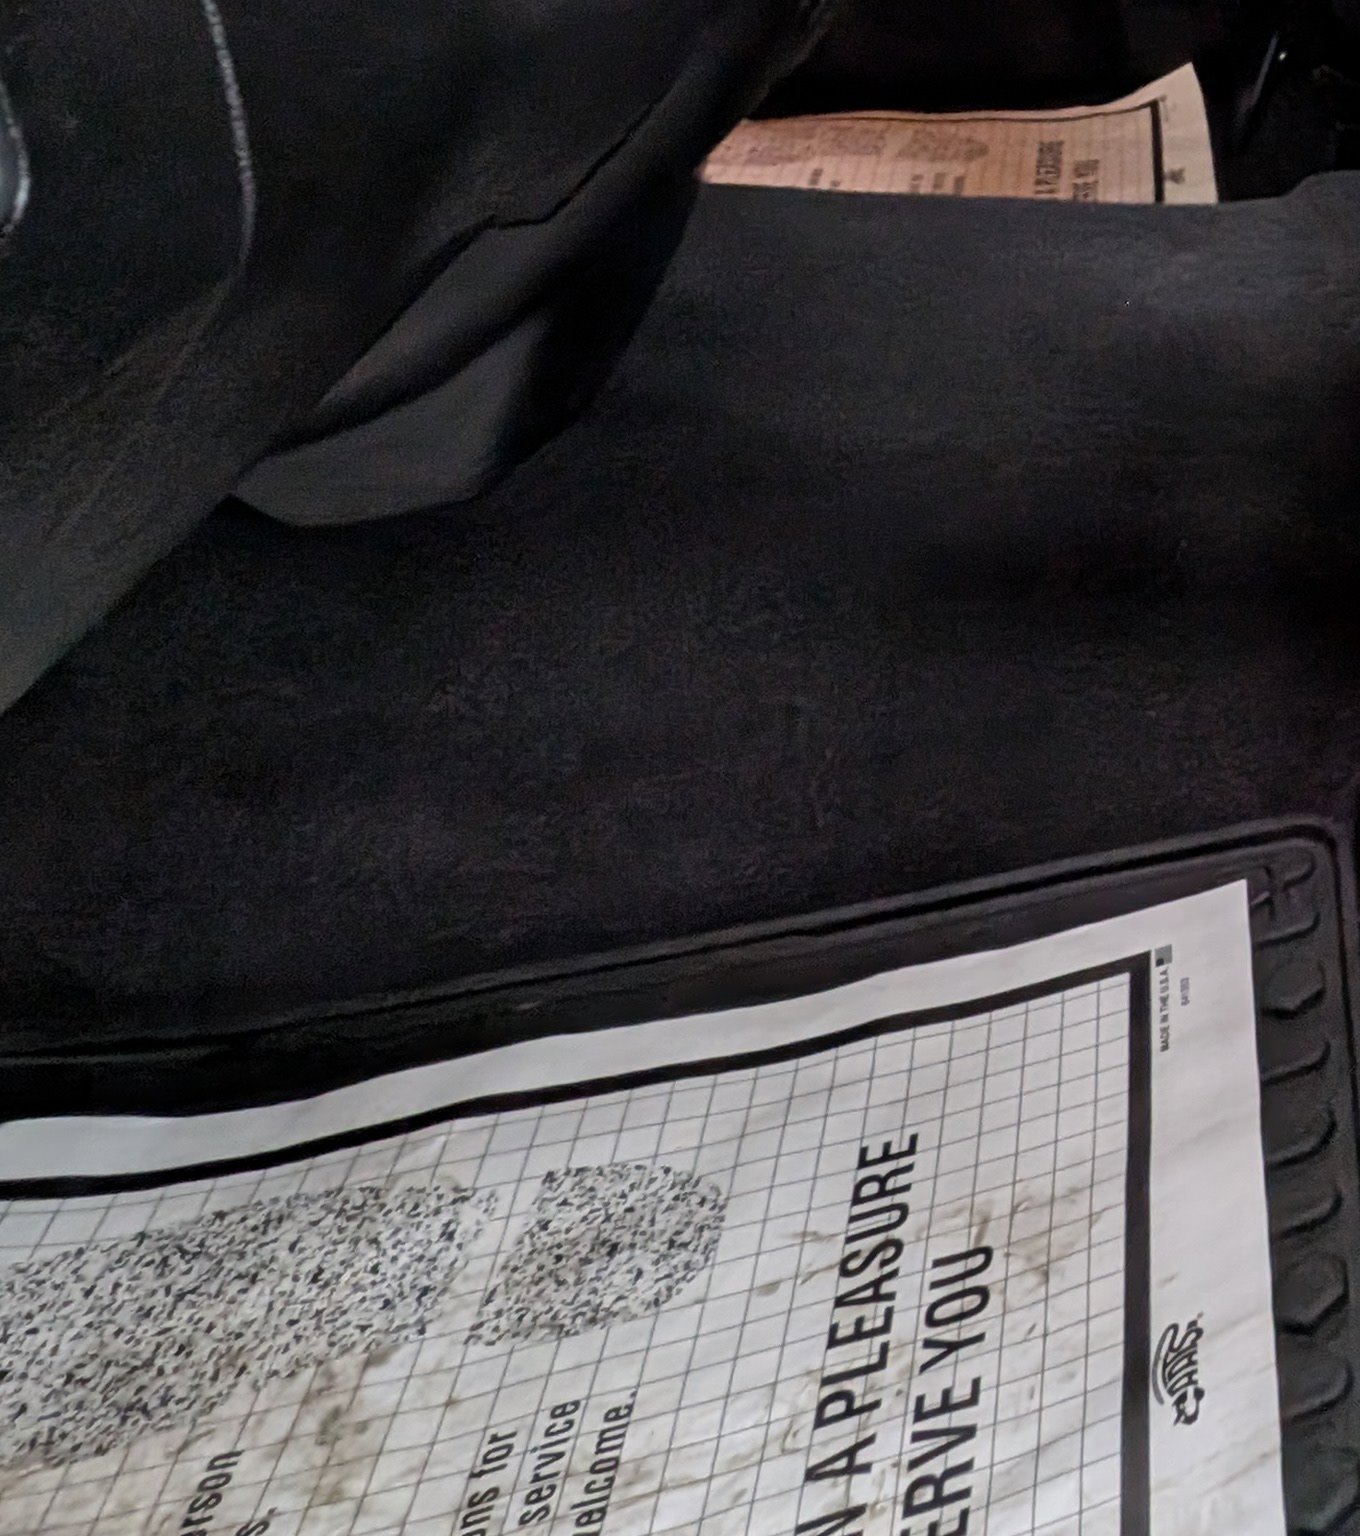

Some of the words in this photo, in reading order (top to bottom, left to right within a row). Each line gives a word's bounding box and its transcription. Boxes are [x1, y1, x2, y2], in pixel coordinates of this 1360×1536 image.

[1159, 1024, 1170, 1053] MADE
[813, 1132, 919, 1430] PLEASURE
[919, 1245, 994, 1375] YOU
[469, 1430, 518, 1479] for
[518, 1399, 581, 1527] service
[804, 1432, 877, 1482] A
